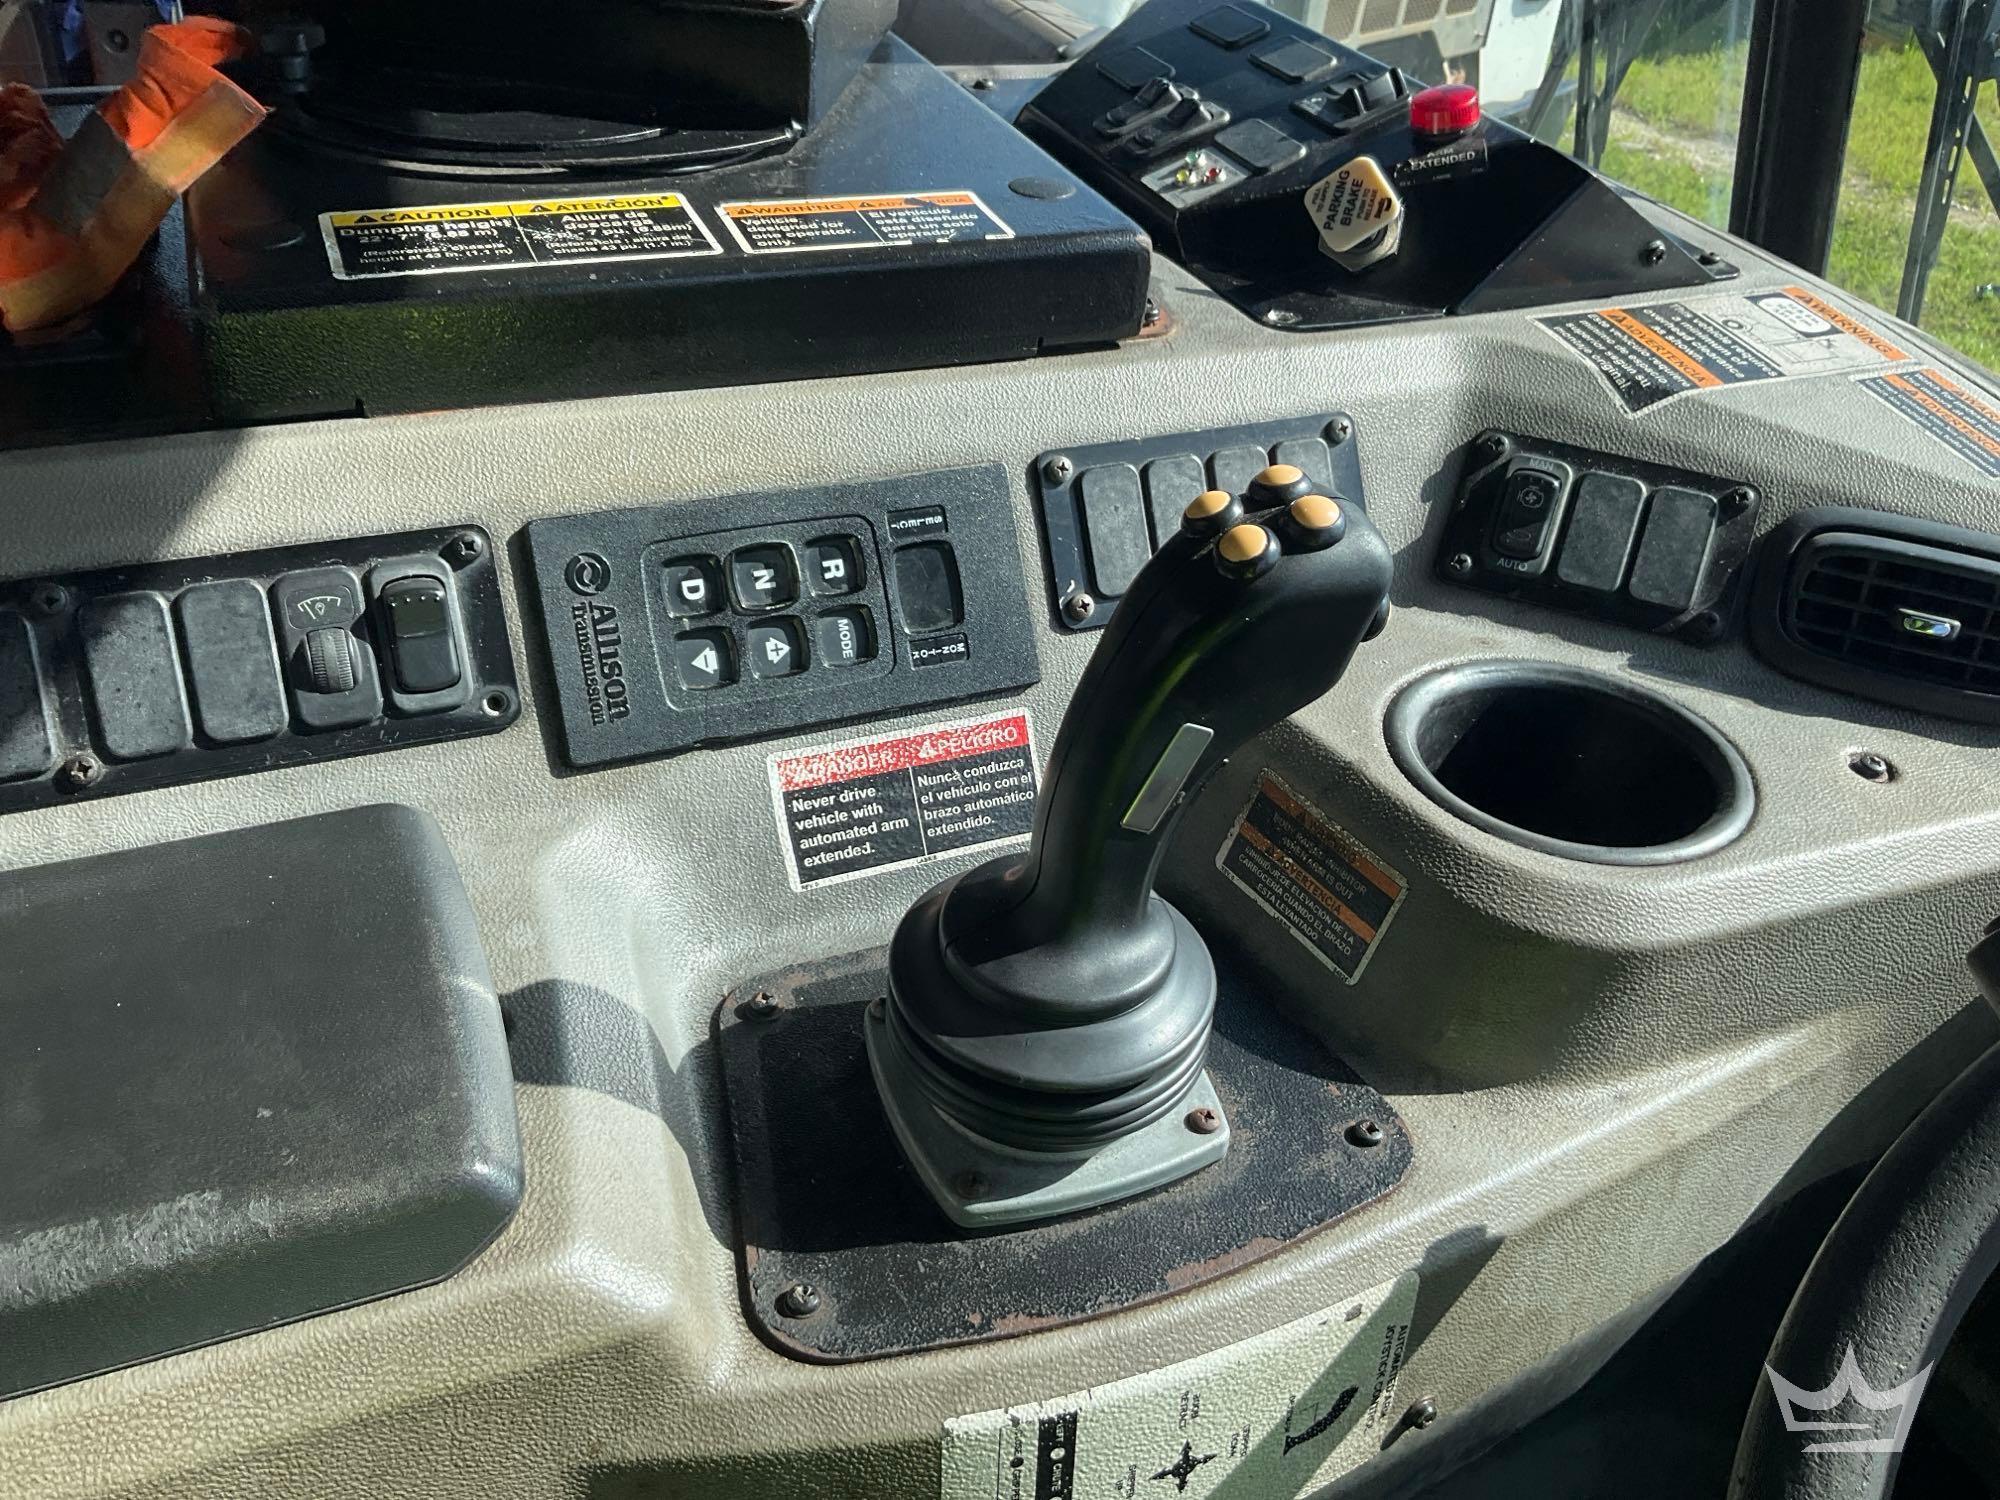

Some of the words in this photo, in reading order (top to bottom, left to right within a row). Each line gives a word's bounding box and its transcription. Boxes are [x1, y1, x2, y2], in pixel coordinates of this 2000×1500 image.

[1410, 150, 1476, 171] EXTENDED
[556, 198, 664, 213] ATENCIÓN
[1323, 170, 1350, 231] PARKING
[1340, 179, 1364, 227] BRAKE
[1364, 188, 1378, 220] RELEASE
[340, 224, 439, 236] Dumping
[442, 218, 512, 231] height
[380, 209, 492, 222] CAUTION
[561, 212, 620, 223] Altura
[624, 210, 649, 219] de
[564, 217, 655, 231] descarga
[747, 220, 819, 233] designed
[820, 219, 845, 229] for
[868, 211, 885, 219] El
[880, 224, 915, 233] para
[919, 221, 940, 230] un
[943, 219, 975, 228] solo
[911, 212, 979, 223] diseñado
[602, 226, 630, 237] pu.
[633, 234, 670, 243] altura
[672, 233, 692, 241] del
[752, 232, 782, 241] one
[757, 239, 797, 248] only.
[887, 227, 956, 240] operador
[408, 253, 423, 261] at
[425, 252, 442, 260] 43
[553, 246, 598, 255] chasis
[601, 244, 617, 252] 43
[620, 242, 642, 252] pu.
[1650, 325, 1667, 335] as
[1811, 299, 1893, 354] WARNING
[1565, 322, 1607, 352] superior
[1634, 373, 1651, 388] su
[1624, 323, 1704, 382] ADVERTENCIA
[1643, 308, 1695, 341] overhead
[1691, 341, 1744, 378] clearance
[1680, 321, 1731, 356] minimum
[1730, 355, 1748, 365] of
[1692, 318, 1731, 345] vehicle
[1730, 344, 1778, 377] requires
[1614, 344, 1629, 355] de
[1627, 353, 1668, 384] espacio
[1649, 356, 1691, 388] requiere
[1529, 459, 1554, 472] MAN
[891, 515, 943, 530] SELECT
[822, 558, 845, 580] R
[1496, 558, 1528, 572] AUTO
[681, 578, 706, 601] D
[752, 568, 777, 590] N
[837, 618, 854, 659] MODE
[912, 642, 966, 660] MONITOR
[571, 601, 606, 727] Transmission
[588, 600, 630, 724] Allison
[937, 726, 1019, 757] PELIGRO
[812, 750, 897, 778] DANGER
[917, 770, 962, 788] Nunca
[963, 758, 1026, 779] conduzca
[792, 793, 836, 813] Never
[839, 786, 876, 804] drive
[921, 793, 934, 805] el
[936, 783, 991, 803] vehículo
[994, 776, 1019, 789] con
[1020, 771, 1033, 784] el
[795, 810, 848, 831] vehicle
[852, 802, 884, 820] with
[923, 805, 962, 822] brazo
[964, 789, 1035, 814] automático
[799, 823, 879, 850] automated
[881, 818, 909, 832] arm
[926, 815, 996, 838] extendido.
[803, 843, 876, 868] extended.
[1333, 880, 1354, 901] OUT
[1274, 899, 1319, 941] LEVANTADO
[1278, 874, 1291, 889] DE
[1331, 920, 1344, 935] DE
[1342, 930, 1356, 945] LA
[1282, 892, 1314, 924] CUANDO
[1313, 919, 1325, 933] EL
[1323, 928, 1352, 956] BRAZO
[1376, 1324, 1396, 1381] JOYSTICK
[1386, 1325, 1408, 1393] AUTOMATED
[1011, 1469, 1023, 1500] GRIPPE
[1050, 1462, 1063, 1492] CHUTE
